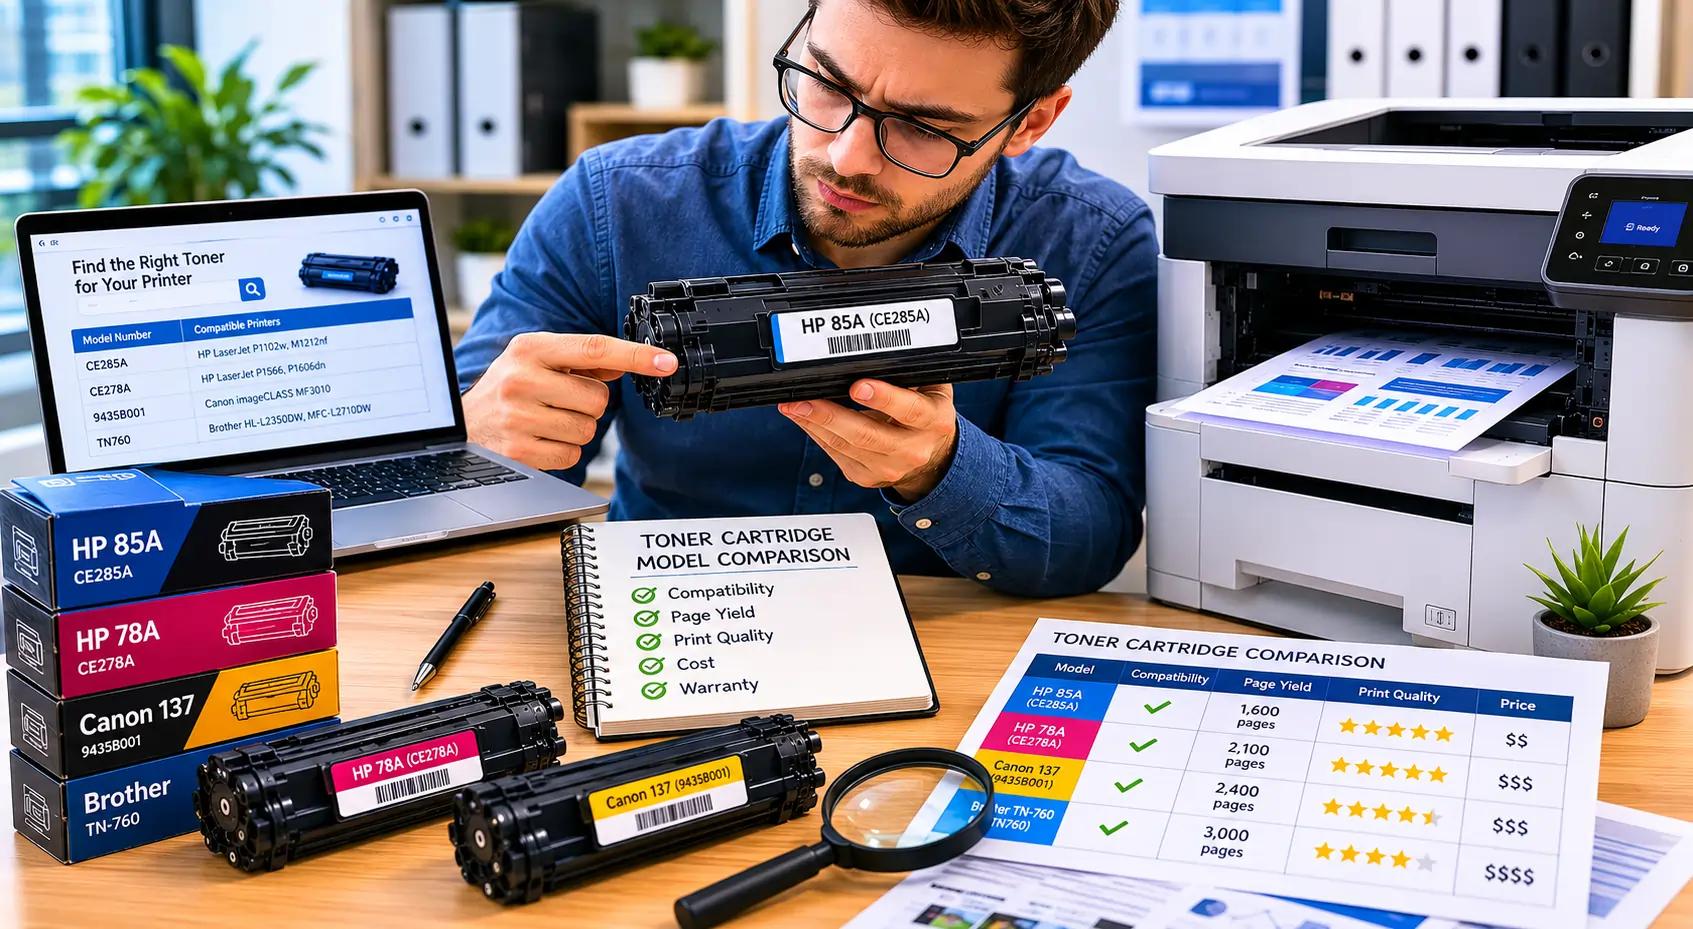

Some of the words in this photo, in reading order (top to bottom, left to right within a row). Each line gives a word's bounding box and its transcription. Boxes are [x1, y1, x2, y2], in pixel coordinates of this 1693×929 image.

[1636, 224, 1660, 233] Ready
[72, 258, 106, 274] Find
[109, 257, 135, 271] the
[139, 253, 179, 272] Right
[182, 252, 225, 266] Toner
[74, 279, 98, 294] for
[101, 277, 137, 292] Your
[142, 273, 192, 289] Printer
[194, 320, 245, 334] Compatible
[247, 318, 281, 328] Printers
[801, 317, 825, 334] HP
[831, 314, 865, 331] 85A
[870, 308, 930, 329] (CE285A)
[83, 333, 112, 345] Model
[114, 330, 152, 342] Number
[197, 349, 211, 359] HP
[213, 346, 251, 358] LaserJet
[252, 342, 289, 353] P1102w,
[291, 336, 327, 348] M1212nf
[86, 358, 128, 371] CE285A
[201, 373, 214, 383] HP
[216, 370, 254, 382] LaserJet
[256, 365, 286, 377] P1566,
[288, 361, 326, 373] P1606dn
[89, 383, 131, 397] CE278A
[205, 398, 234, 408] Canon
[236, 389, 294, 405] imageCLASS
[295, 384, 331, 397] MF3010
[93, 407, 145, 423] 9435B001
[209, 422, 242, 433] Brother
[244, 413, 306, 428] HL-L2350DW,
[307, 404, 371, 420] MFC-L2710DW
[96, 435, 131, 448] TN760
[73, 536, 107, 561] HP
[114, 529, 163, 556] 85A
[640, 532, 713, 549] TONER
[721, 527, 835, 545] CARTRIDGE
[637, 553, 710, 570] MODEL
[717, 547, 850, 566] COMPARISON
[74, 565, 133, 584] CE285A
[668, 582, 774, 601] Compatibility
[671, 610, 711, 625] Page
[715, 605, 755, 620] Yield
[77, 627, 109, 652] HP
[115, 620, 160, 646] 78A
[674, 633, 712, 646] Print
[717, 629, 773, 645] Quality
[1054, 632, 1119, 648] TONER
[1126, 638, 1239, 658] CARTRIDGE
[1246, 648, 1385, 669] COMPARISON
[78, 654, 135, 675] CE278A
[677, 656, 715, 670] Cost
[1055, 662, 1095, 674] Model
[1131, 669, 1210, 686] Compatibility
[1244, 678, 1276, 691] Page
[1280, 680, 1312, 692] Yield
[679, 678, 759, 695] Warranty
[1032, 686, 1053, 696] HP
[1056, 688, 1082, 699] 85A
[1359, 687, 1390, 698] Print
[1393, 689, 1441, 705] Quality
[1501, 698, 1536, 711] Price
[1026, 698, 1078, 712] (CE285A)
[1241, 704, 1280, 717] 1,600
[80, 708, 153, 735] Canon
[158, 694, 194, 719] 137
[1014, 722, 1035, 733] HP
[1038, 724, 1065, 737] 78A
[1237, 719, 1275, 730] pages
[81, 734, 140, 758] 9435B001
[1007, 735, 1061, 749] (CE278A)
[1506, 732, 1528, 748] $$
[1228, 742, 1269, 756] 2,100
[352, 764, 372, 781] HP
[375, 756, 404, 774] 78A
[404, 740, 458, 768] (CE278A)
[994, 760, 1034, 774] Canon
[1039, 765, 1061, 776] 137
[1225, 758, 1265, 770] pages
[606, 791, 647, 809] Canon
[650, 781, 670, 797] 137
[675, 766, 730, 792] (9435B001)
[991, 773, 1053, 790] (9435B001)
[1215, 782, 1259, 797] 2,400
[1498, 774, 1532, 792] $$$
[84, 780, 171, 814] Brother
[1013, 805, 1055, 820] TN-760
[1213, 800, 1254, 813] pages
[85, 812, 140, 836] TN-760
[1493, 817, 1528, 836] $$$
[1204, 826, 1249, 842] 3,000
[1200, 845, 1243, 859] pages
[1485, 864, 1534, 886] $$$$
